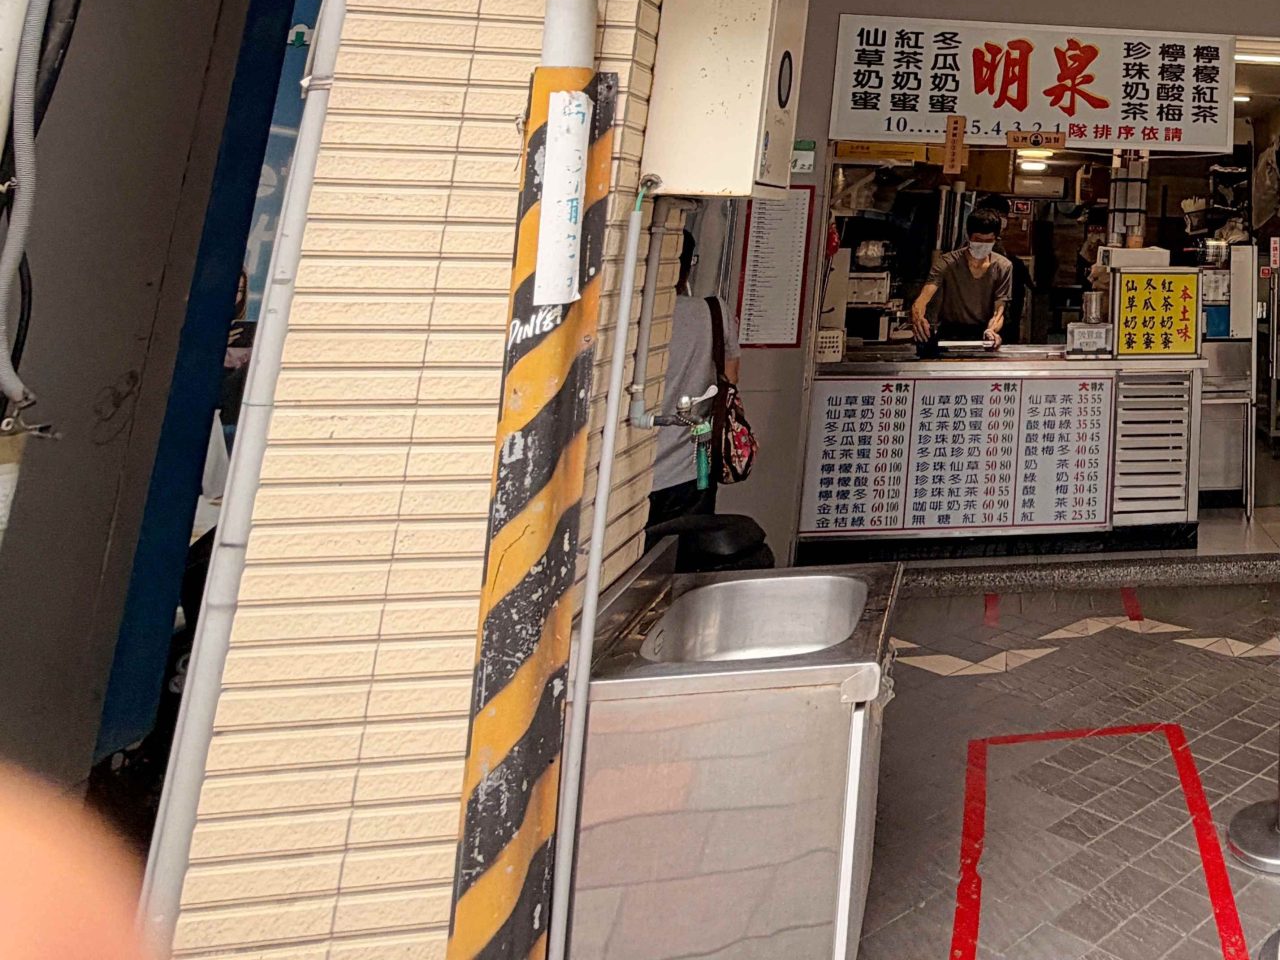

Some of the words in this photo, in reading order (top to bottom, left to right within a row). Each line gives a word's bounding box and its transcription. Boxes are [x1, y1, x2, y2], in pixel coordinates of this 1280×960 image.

[851, 27, 886, 110] 仙草奶蜜
[890, 29, 924, 112] 紅茶奶蜜
[928, 32, 962, 113] 冬瓜奶蜜
[972, 38, 1111, 117] 明泉
[1121, 42, 1151, 121] 珍珠奶茶
[1156, 43, 1185, 121] 檸檬酸梅
[1191, 45, 1219, 123] 檸檬紅茶
[1123, 279, 1138, 349] 仙草奶蜜
[1142, 278, 1157, 349] 冬瓜奶蜜
[1160, 278, 1174, 349] 紅茶奶蜜
[1176, 285, 1193, 342] 本土味
[882, 384, 894, 392] 大
[896, 383, 910, 392] 特大
[991, 383, 1002, 392] 大
[1004, 383, 1018, 392] 特大
[1079, 383, 1089, 391] 大
[1091, 383, 1104, 391] 特大
[827, 396, 876, 406] 仙草蜜
[880, 396, 892, 405] 50
[895, 396, 907, 405] 80
[922, 395, 984, 405] 仙草奶蜜
[990, 396, 1000, 404] 60
[1004, 395, 1015, 404] 90
[1029, 395, 1073, 404] 仙草茶
[1078, 395, 1088, 404] 35
[1091, 395, 1102, 404] 55
[826, 409, 874, 419] 仙草奶
[879, 409, 891, 419] 50
[894, 409, 906, 419] 80
[920, 408, 983, 418] 冬瓜奶蜜
[989, 409, 1000, 417] 60
[1003, 408, 1015, 417] 90
[1028, 407, 1072, 417] 冬瓜茶
[1077, 408, 1088, 416] 35
[1091, 408, 1101, 416] 55
[825, 422, 873, 432] 冬瓜奶
[878, 422, 890, 432] 50
[893, 422, 905, 432] 80
[919, 421, 982, 431] 紅茶奶蜜
[988, 422, 999, 430] 60
[1002, 421, 1014, 430] 90
[1026, 420, 1071, 430] 酸梅綠
[1077, 420, 1087, 429] 35
[1090, 420, 1100, 429] 55
[824, 436, 872, 446] 冬瓜蜜
[877, 435, 889, 445] 50
[892, 435, 904, 445] 80
[918, 434, 981, 444] 珍珠奶茶
[987, 434, 998, 443] 50
[1002, 434, 1013, 443] 80
[1026, 433, 1070, 443] 酸梅紅
[1076, 433, 1087, 442] 30
[1089, 432, 1100, 441] 45
[822, 449, 871, 459] 紅茶蜜
[876, 449, 888, 458] 50
[891, 449, 903, 458] 80
[917, 447, 980, 458] 冬瓜珍奶
[986, 447, 997, 456] 60
[1001, 447, 1012, 456] 90
[1025, 445, 1070, 456] 酸梅冬
[1075, 446, 1086, 454] 40
[1088, 445, 1100, 454] 65
[821, 463, 870, 474] 檸檬紅
[875, 463, 887, 472] 60
[889, 463, 902, 472] 100
[916, 461, 979, 472] 珍珠仙草
[985, 461, 996, 470] 50
[1000, 461, 1011, 470] 80
[1075, 459, 1085, 468] 40
[1088, 459, 1099, 468] 55
[820, 477, 868, 488] 檸檬酸
[874, 477, 885, 486] 65
[888, 476, 901, 486] 110
[916, 474, 978, 485] 珍珠冬瓜
[984, 474, 996, 483] 50
[999, 474, 1011, 483] 80
[1074, 472, 1084, 481] 45
[1087, 472, 1098, 481] 65
[818, 490, 867, 500] 檸檬冬
[873, 490, 884, 499] 70
[887, 489, 900, 499] 120
[914, 487, 978, 498] 珍珠紅茶
[983, 487, 995, 496] 40
[998, 487, 1009, 496] 55
[1073, 485, 1084, 494] 30
[1087, 485, 1097, 493] 45
[913, 501, 977, 511] 咖啡奶茶
[983, 501, 994, 509] 60
[997, 500, 1009, 509] 90
[1072, 498, 1084, 507] 30
[1086, 498, 1097, 506] 45
[817, 504, 866, 514] 金桔紅
[872, 504, 884, 513] 60
[886, 503, 899, 512] 100
[982, 513, 993, 523] 30
[997, 513, 1008, 522] 45
[1072, 511, 1083, 520] 25
[1085, 510, 1096, 519] 35
[816, 518, 865, 528] 金桔綠
[870, 517, 882, 527] 65
[885, 516, 898, 526] 110
